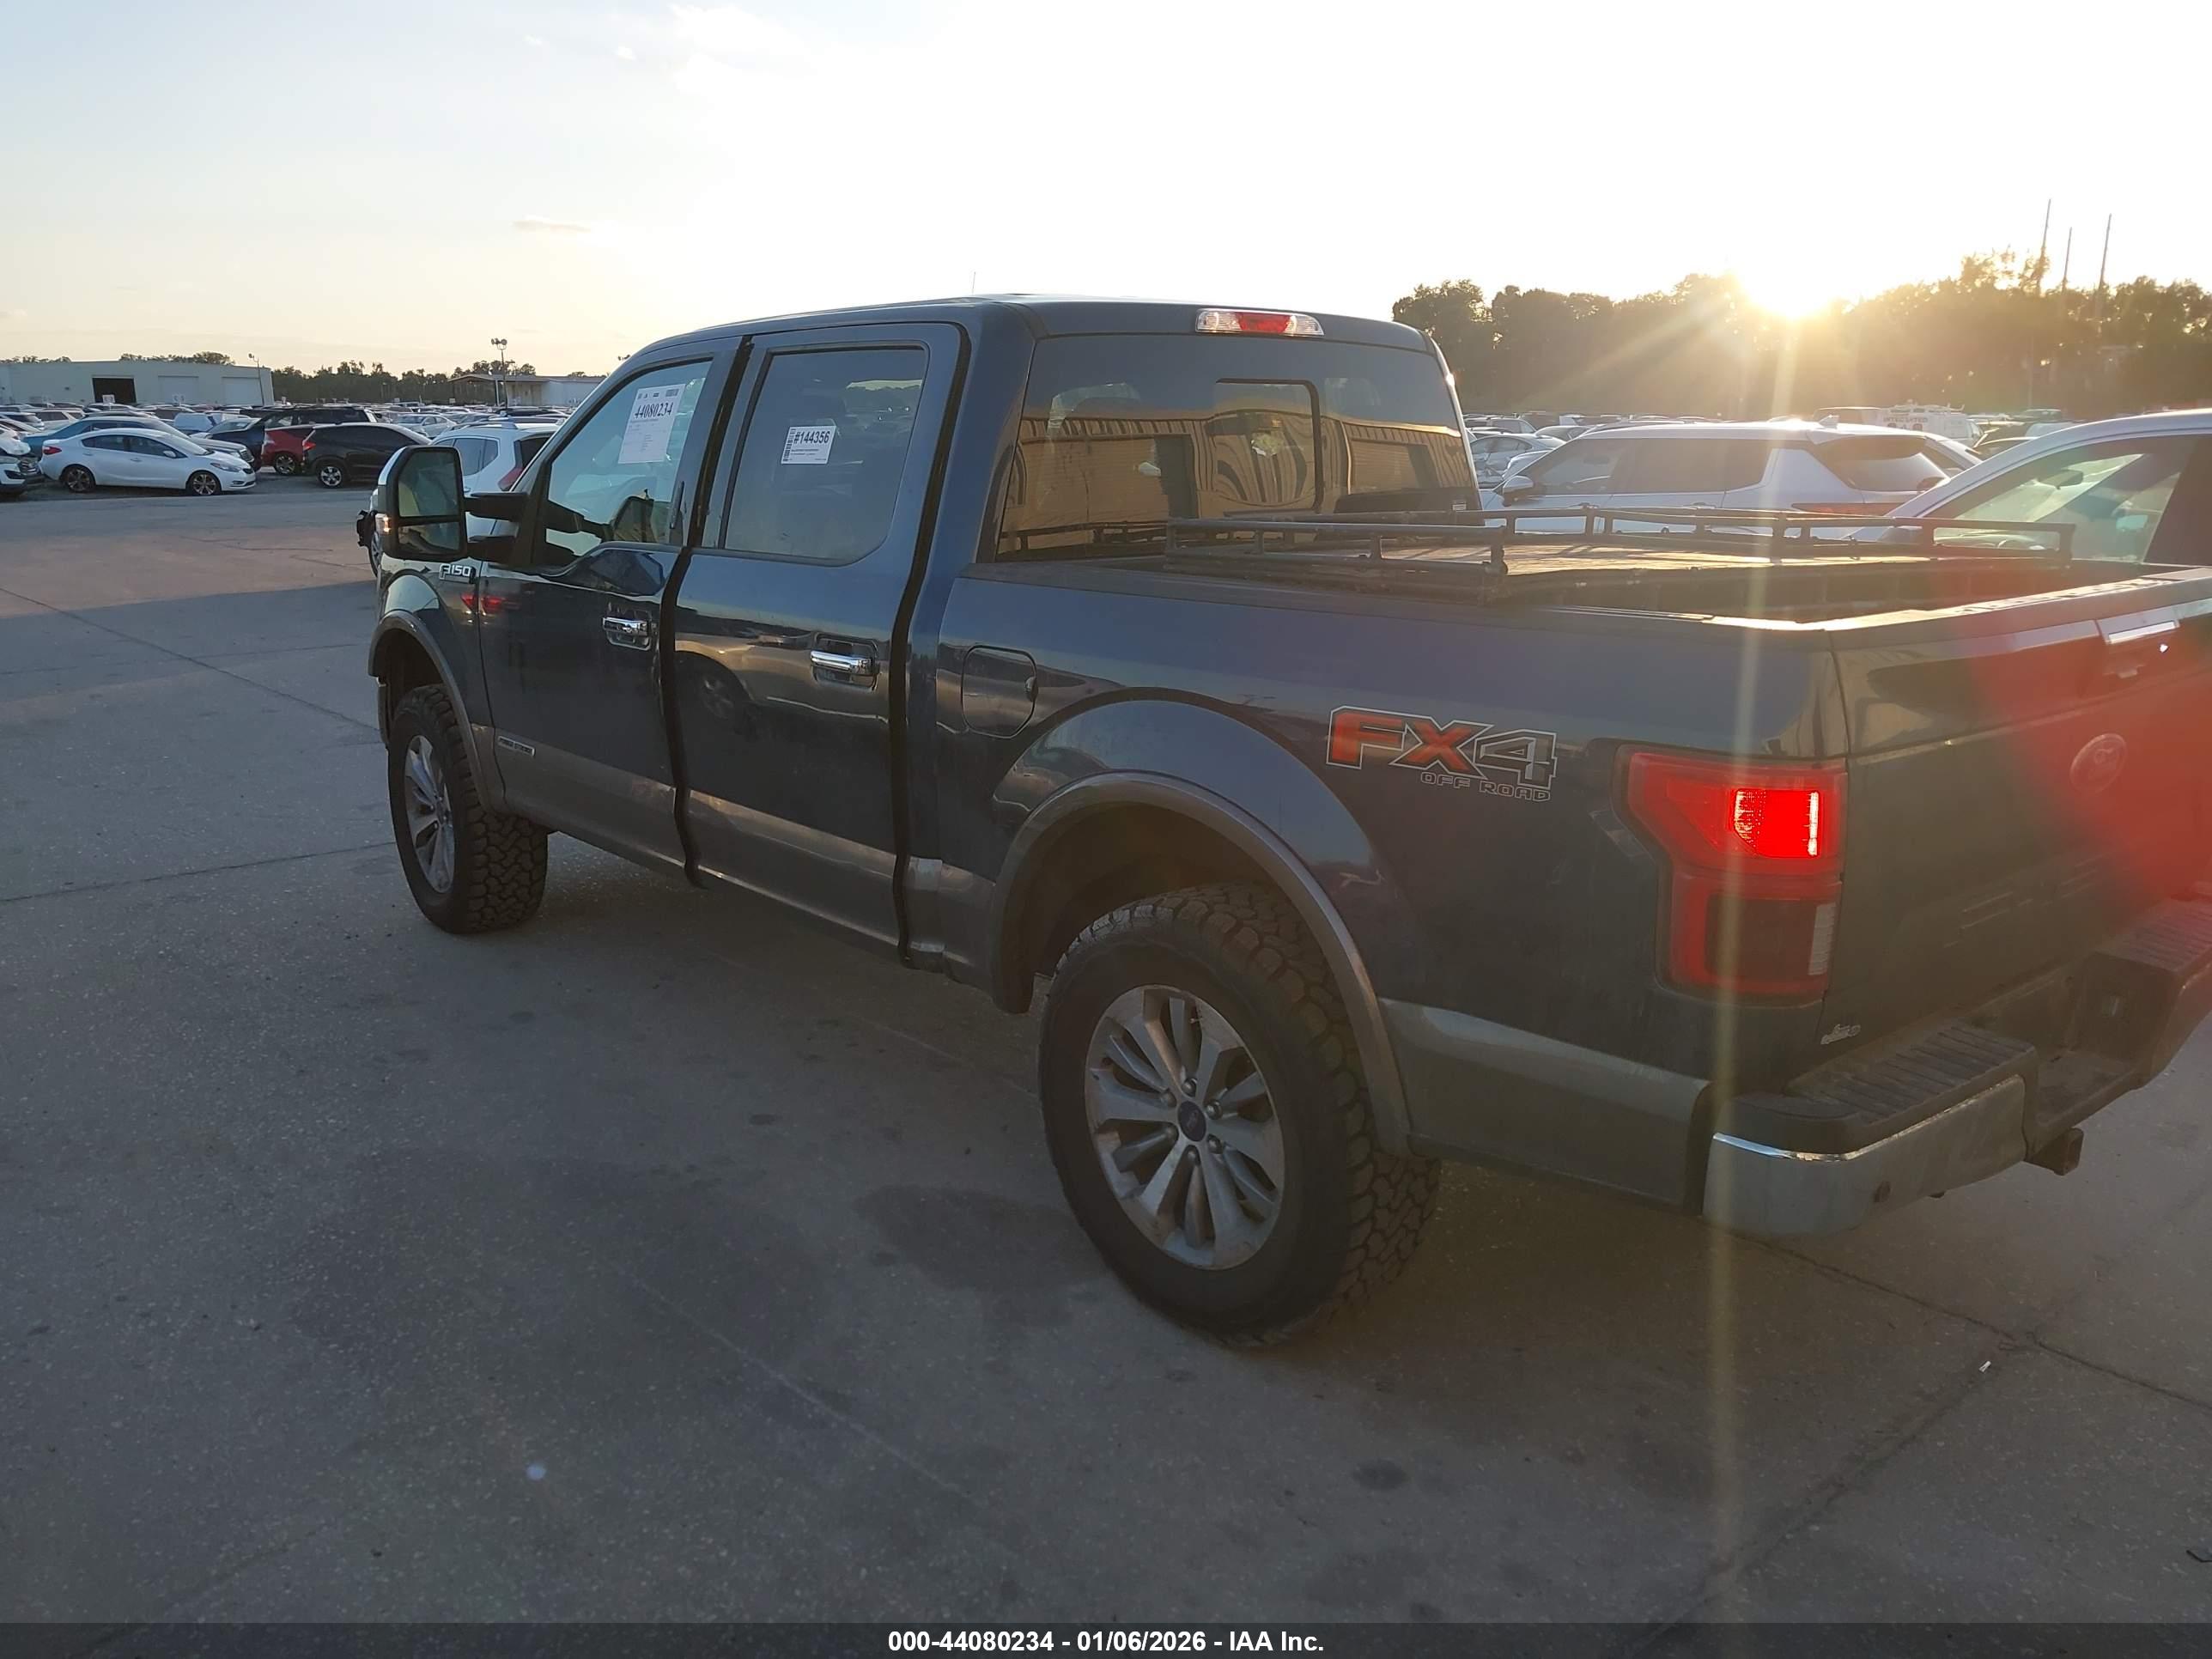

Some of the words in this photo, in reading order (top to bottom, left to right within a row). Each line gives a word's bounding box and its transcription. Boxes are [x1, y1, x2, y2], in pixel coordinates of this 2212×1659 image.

[634, 401, 674, 420] 44080234
[793, 430, 830, 445] #144356
[1326, 705, 1558, 790] FX4
[1420, 771, 1470, 788] OFF
[1479, 780, 1551, 802] ROAD
